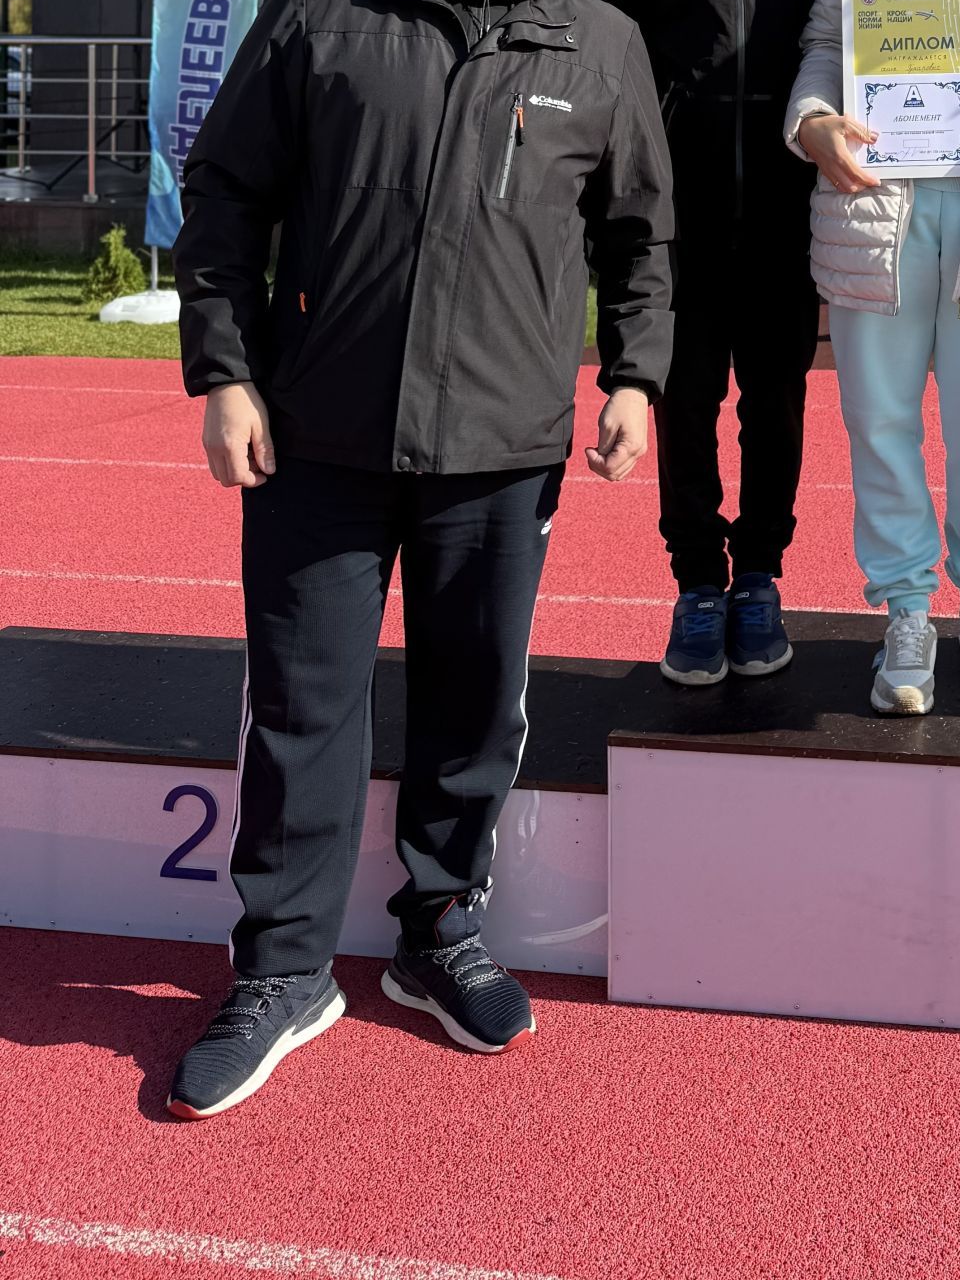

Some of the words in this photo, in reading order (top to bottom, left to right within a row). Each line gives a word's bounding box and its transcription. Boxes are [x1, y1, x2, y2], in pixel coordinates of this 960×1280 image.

[880, 36, 954, 52] ДИПЛОМ
[894, 114, 942, 122] АБОНЕМЕНТ
[160, 784, 217, 881] 2
